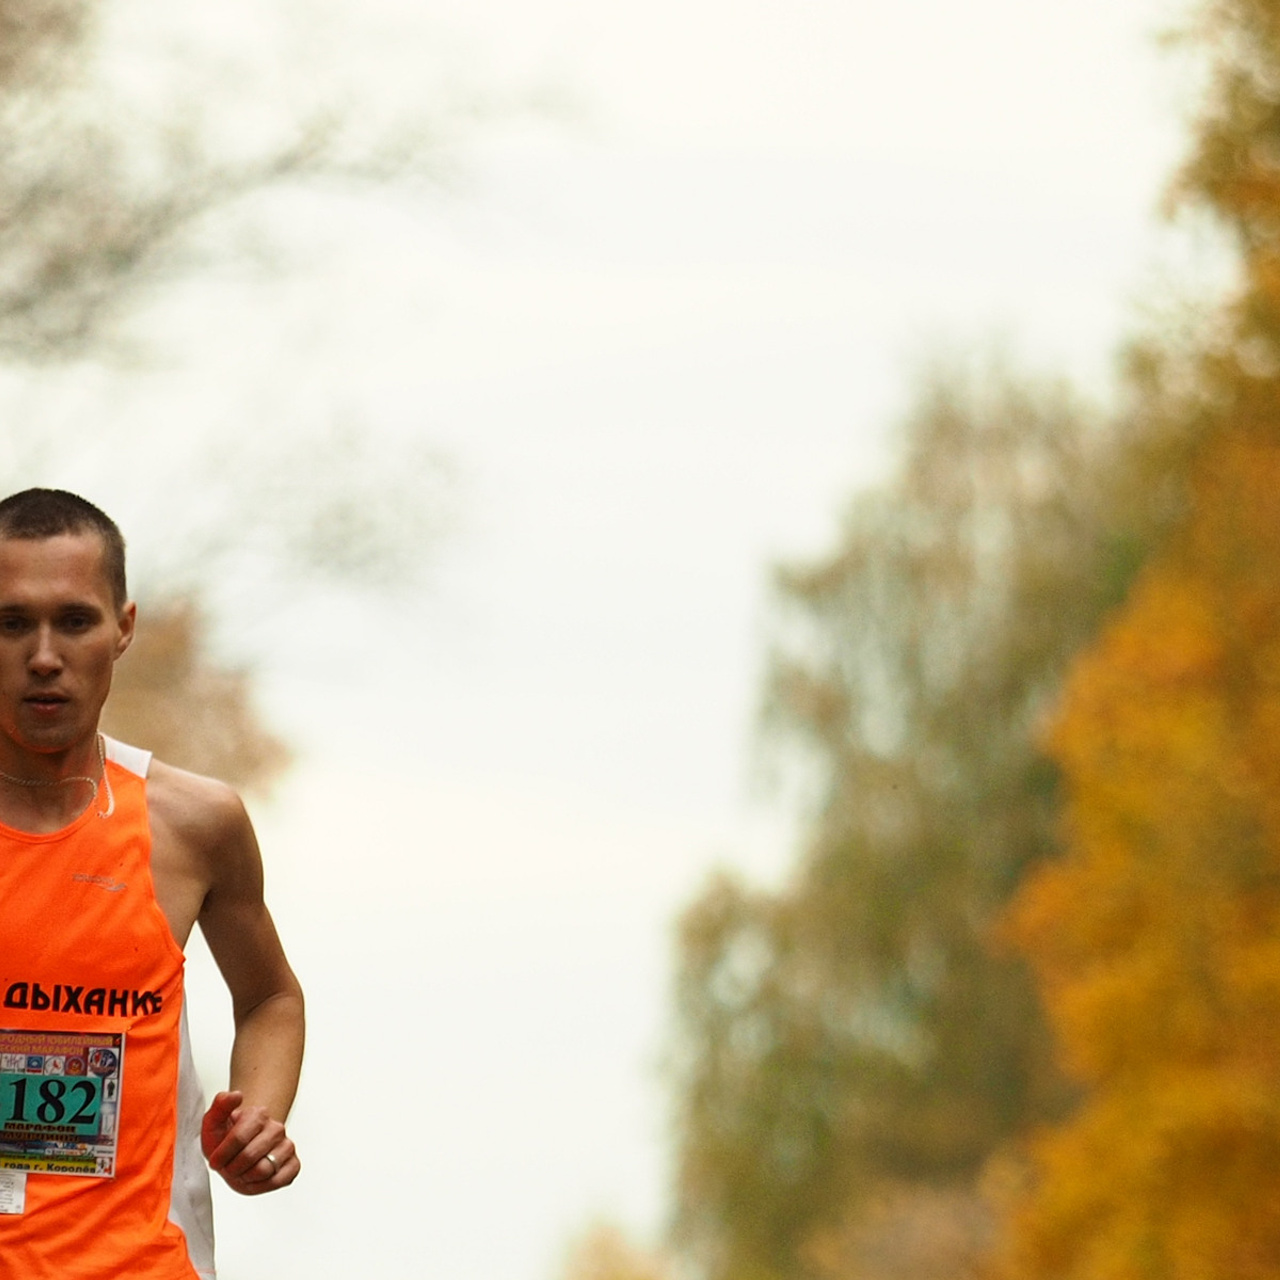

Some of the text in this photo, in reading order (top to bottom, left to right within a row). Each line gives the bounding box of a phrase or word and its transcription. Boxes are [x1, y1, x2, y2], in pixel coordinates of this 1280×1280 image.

[3, 981, 163, 1018] ДЫХАНИЕ
[4, 1122, 76, 1133] МАРАФОН
[4, 1161, 30, 1170] года
[34, 1163, 43, 1171] г.
